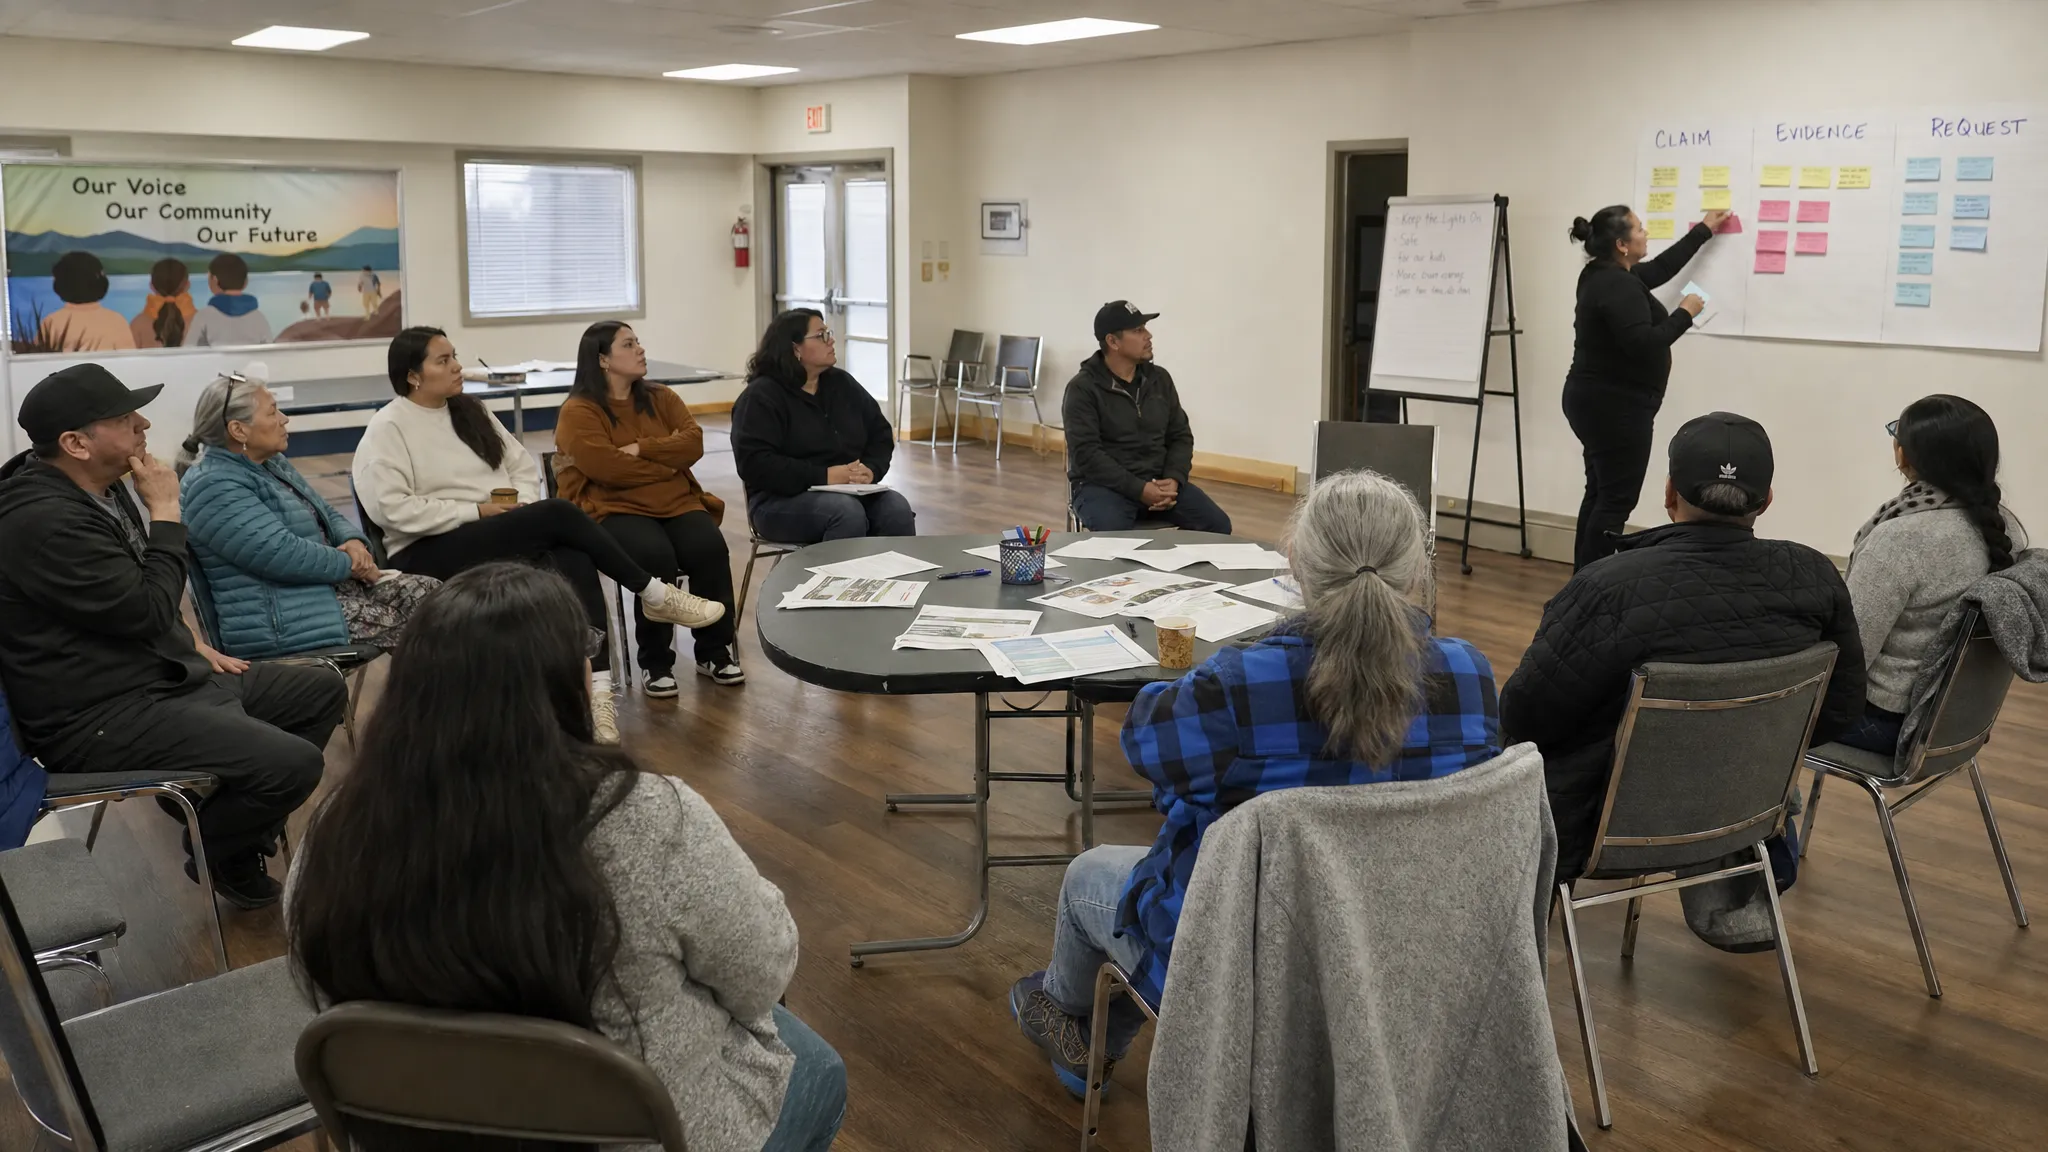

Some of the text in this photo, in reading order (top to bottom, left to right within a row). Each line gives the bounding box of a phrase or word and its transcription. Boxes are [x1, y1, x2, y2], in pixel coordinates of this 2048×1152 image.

[807, 106, 823, 129] EXIT
[1931, 117, 2028, 138] REQUEST
[1655, 129, 1712, 149] CLAIM
[1776, 122, 1868, 143] EVIDENCE
[73, 177, 187, 196] Our Voice
[106, 202, 272, 224] Our Community
[1441, 210, 1466, 231] Lights
[197, 227, 318, 244] Our Future
